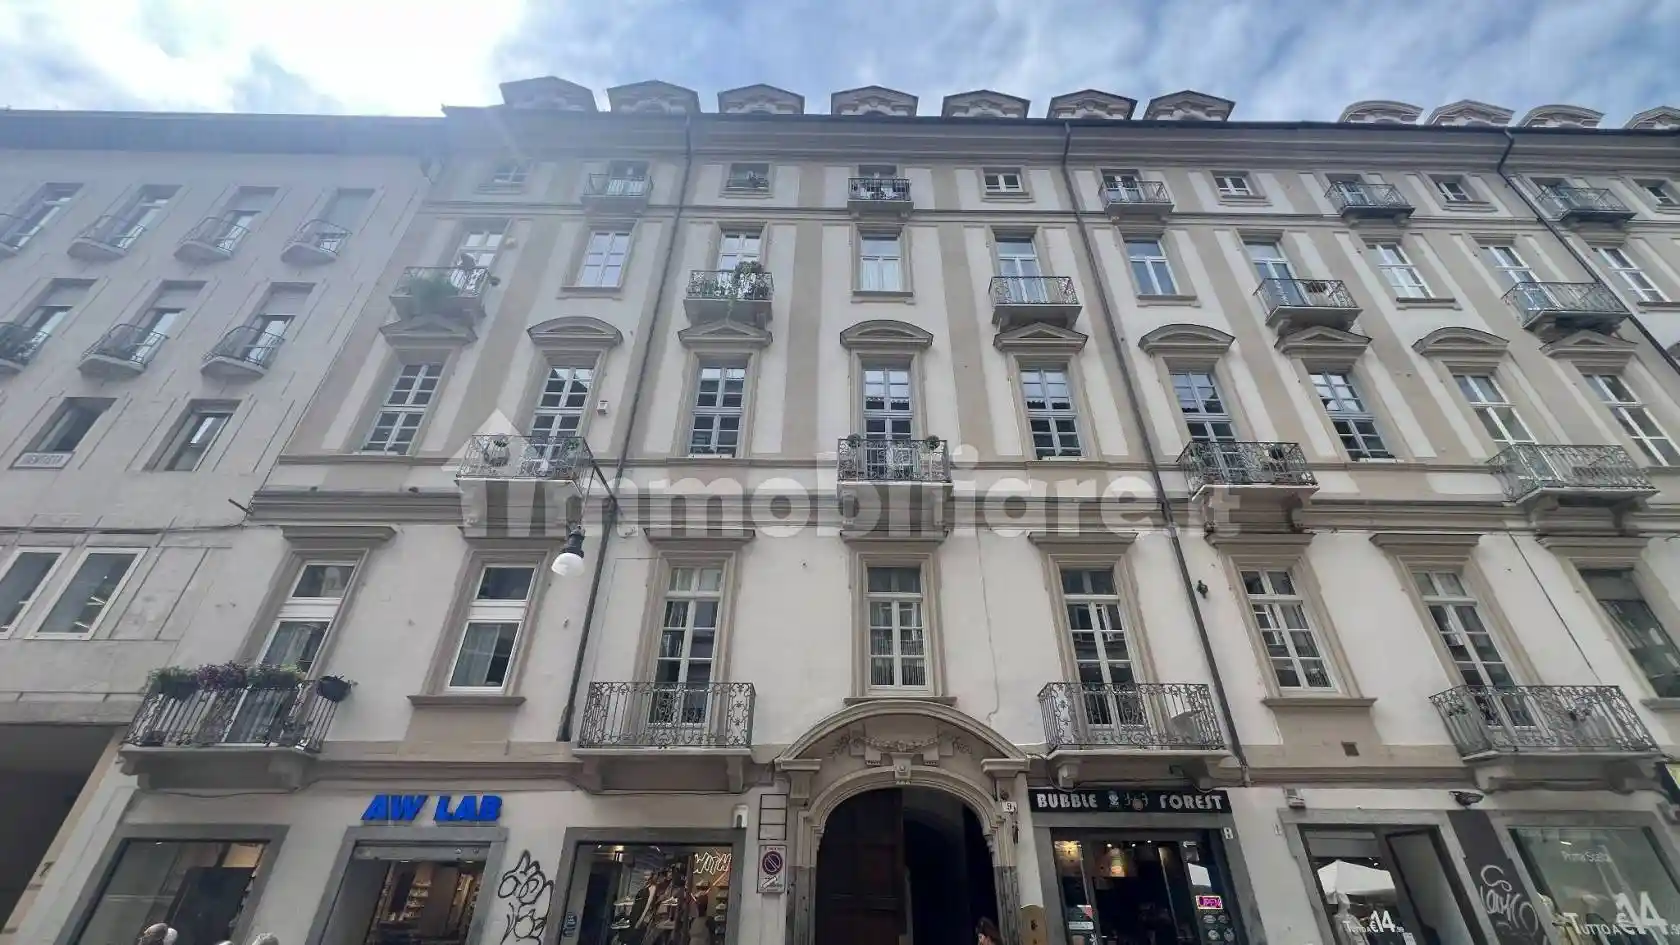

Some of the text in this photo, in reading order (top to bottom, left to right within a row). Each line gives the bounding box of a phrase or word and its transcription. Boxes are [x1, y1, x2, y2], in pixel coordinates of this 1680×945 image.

[361, 795, 503, 821] AW LAB
[1036, 793, 1224, 810] BUBBLE FOREST
